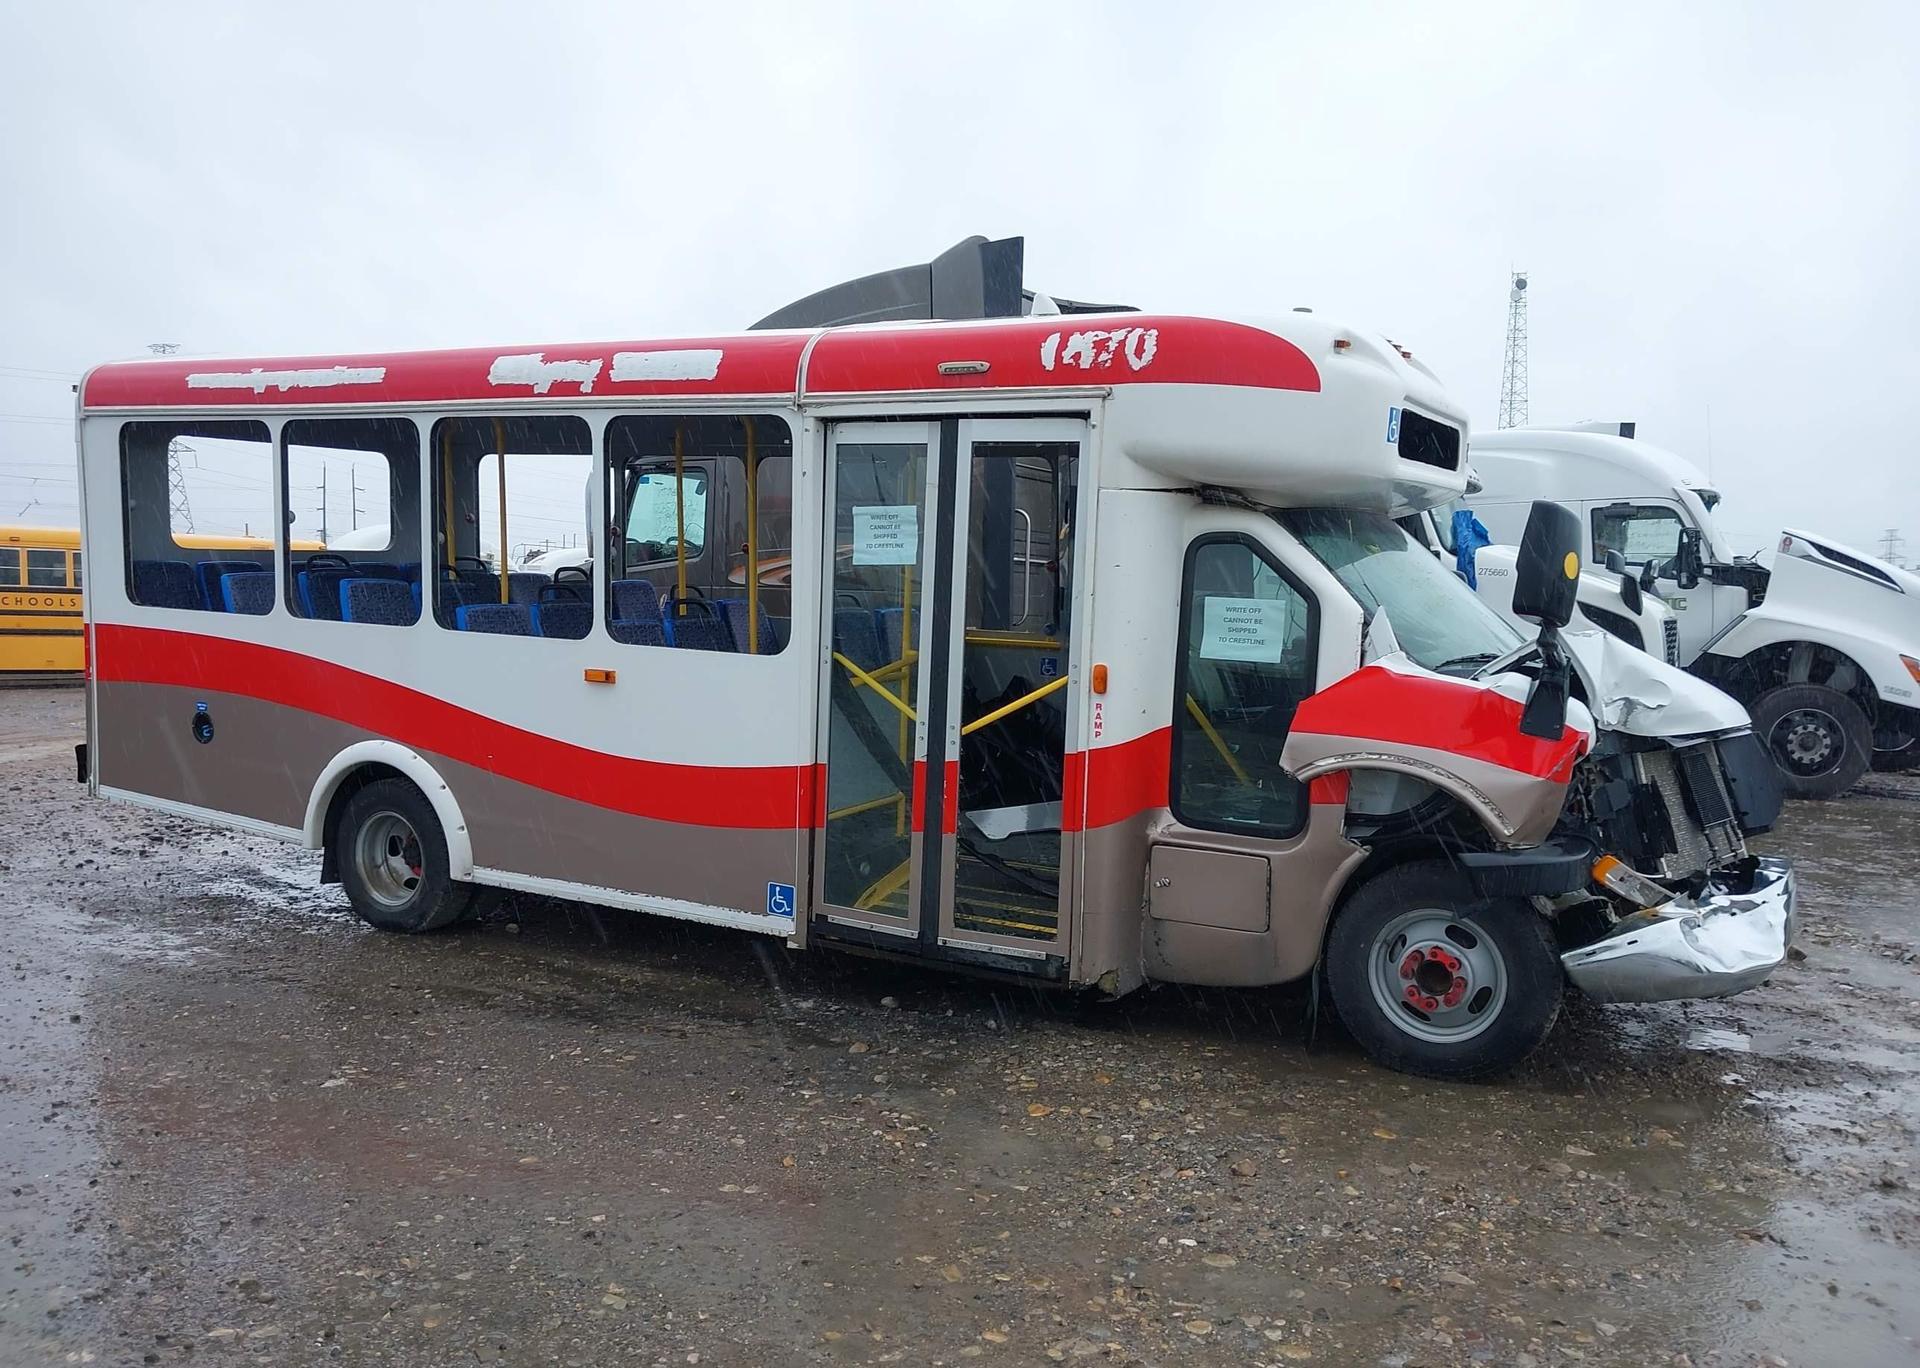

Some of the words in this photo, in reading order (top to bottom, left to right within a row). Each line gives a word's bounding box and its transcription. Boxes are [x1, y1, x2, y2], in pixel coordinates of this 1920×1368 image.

[1225, 606, 1247, 614] WRITE
[1223, 616, 1252, 624] CANNOT
[1227, 626, 1258, 634] SHIPPED
[1228, 637, 1265, 646] CRESTLINE
[1094, 703, 1103, 739] RAMP
